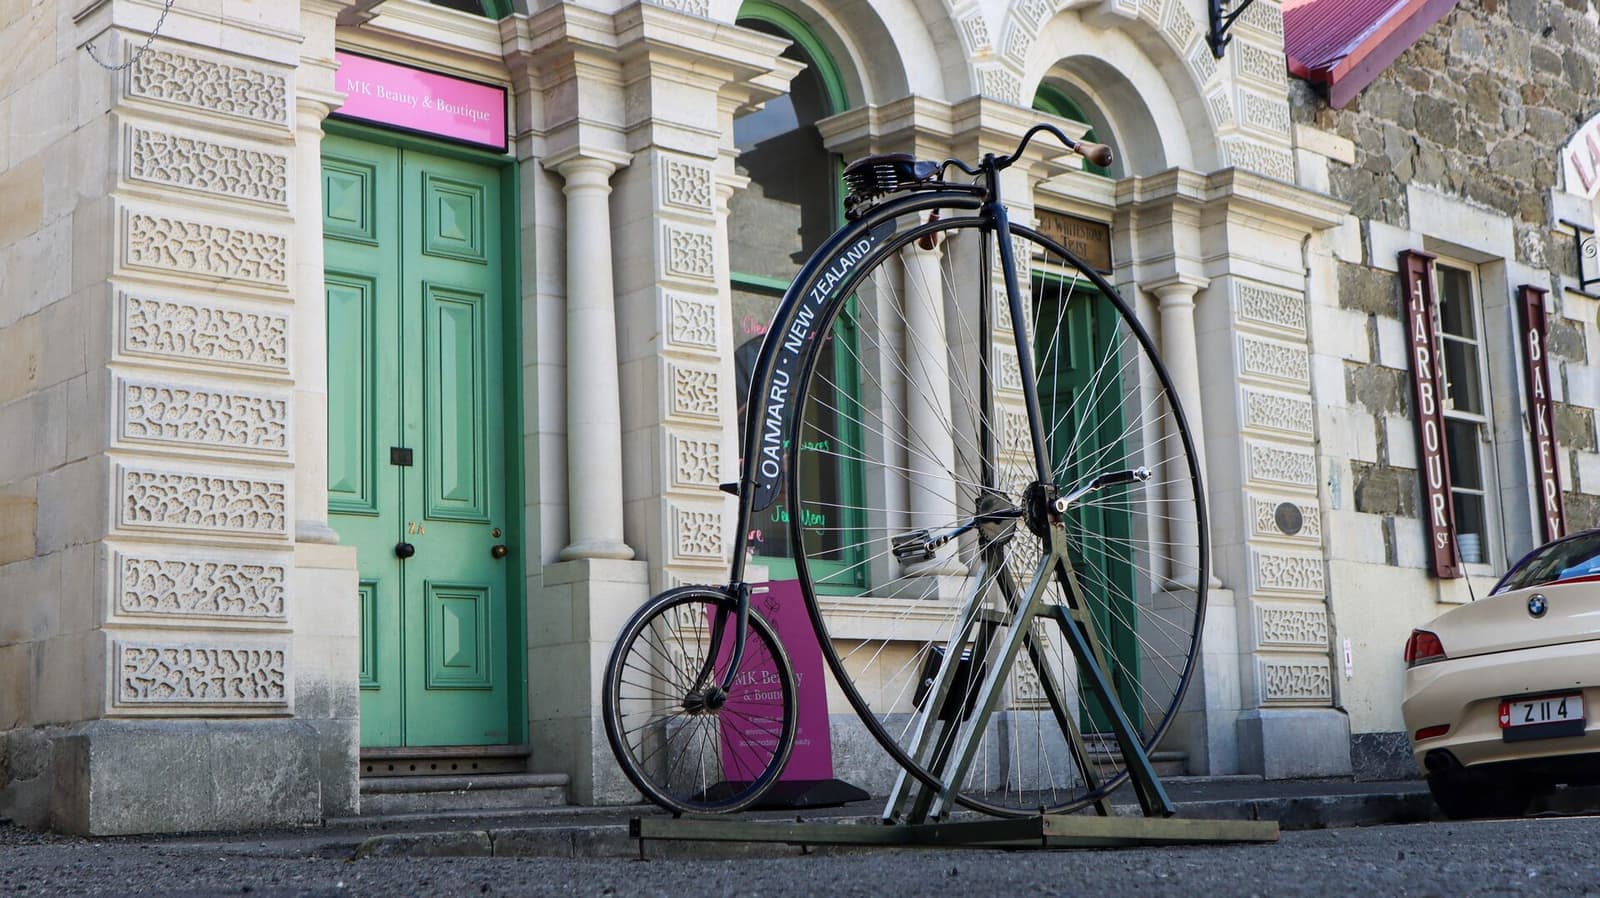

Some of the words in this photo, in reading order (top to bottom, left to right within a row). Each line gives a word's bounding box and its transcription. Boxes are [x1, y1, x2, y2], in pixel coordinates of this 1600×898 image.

[346, 79, 372, 96] MK
[376, 85, 419, 107] Beauty
[422, 95, 433, 109] &
[437, 98, 491, 122] Boutique
[761, 369, 791, 479] OAMARU
[784, 304, 815, 355] NEW
[810, 239, 872, 305] ZEALAND
[1412, 279, 1448, 528] HARBOUR
[1529, 327, 1560, 540] BAKERY
[735, 670, 758, 686] MK
